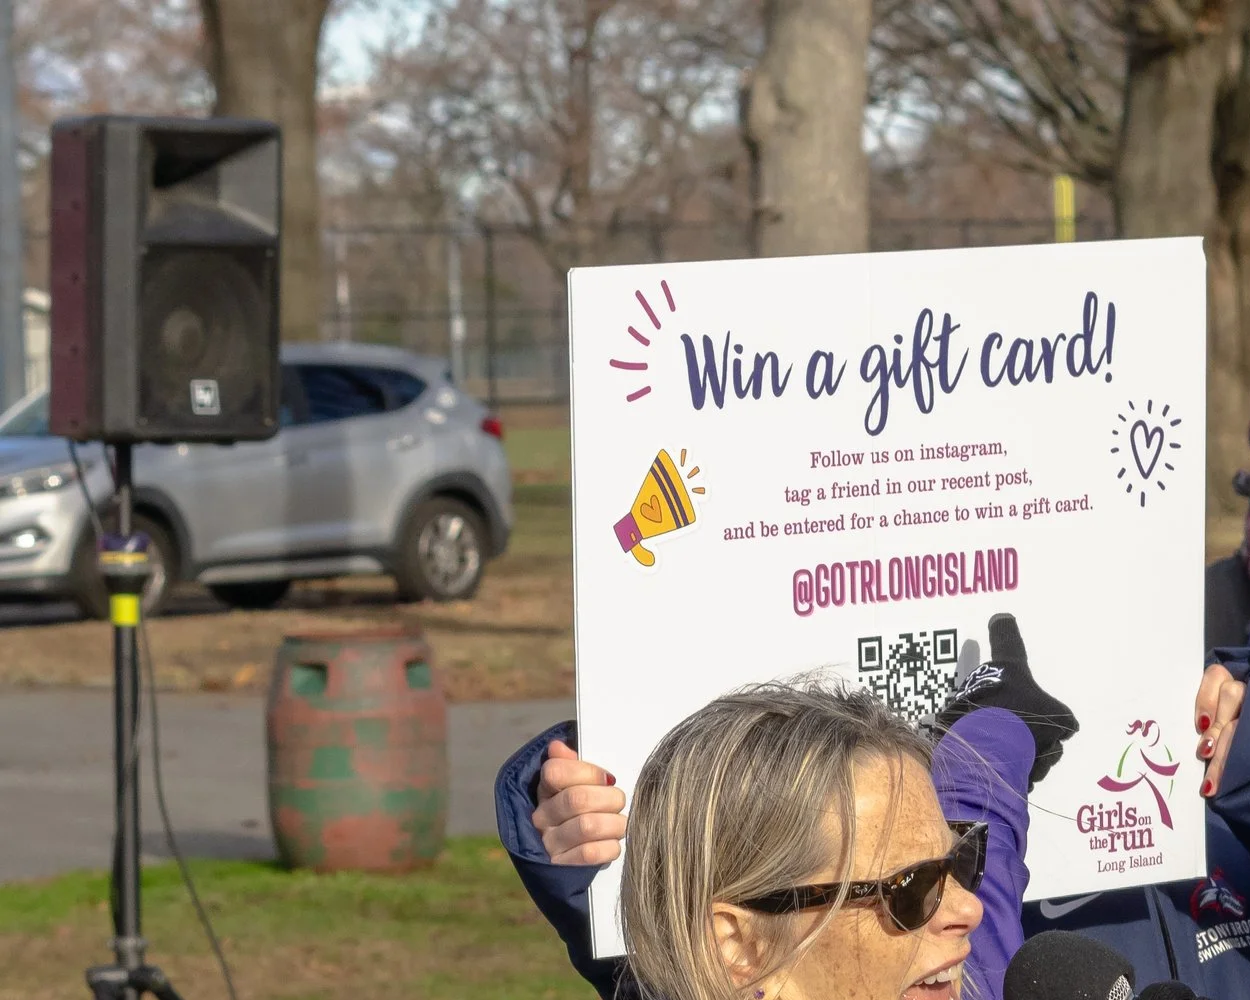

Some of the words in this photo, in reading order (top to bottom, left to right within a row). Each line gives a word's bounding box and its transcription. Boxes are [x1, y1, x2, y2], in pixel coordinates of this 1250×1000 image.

[680, 330, 793, 410] Win
[805, 349, 847, 400] a
[859, 308, 969, 436] gift
[980, 291, 1116, 387] card!
[810, 450, 864, 469] Follow
[870, 450, 889, 464] us
[894, 449, 914, 462] on
[919, 442, 1008, 461] instagram,
[784, 486, 811, 506] tag
[816, 487, 826, 500] a
[831, 479, 880, 499] friend
[886, 478, 902, 494] in
[907, 479, 936, 493] our
[941, 471, 990, 490] recent
[995, 467, 1033, 490] post,
[723, 522, 755, 540] and
[760, 520, 779, 537] be
[784, 514, 845, 535] entered
[850, 513, 874, 530] for
[879, 514, 888, 527] a
[893, 509, 949, 526] chance
[955, 505, 969, 521] to
[975, 502, 1003, 519] win
[1009, 504, 1018, 517] a
[1022, 497, 1051, 520] gift
[1055, 494, 1093, 513] card.
[792, 547, 1019, 617] @GOTRLONGISLAND
[1077, 801, 1137, 833] Girls
[1138, 816, 1151, 826] on
[1089, 836, 1108, 850] the
[1108, 827, 1154, 852] run
[1097, 860, 1126, 873] Long
[1129, 852, 1163, 868] Island
[1196, 923, 1231, 949] STONY
